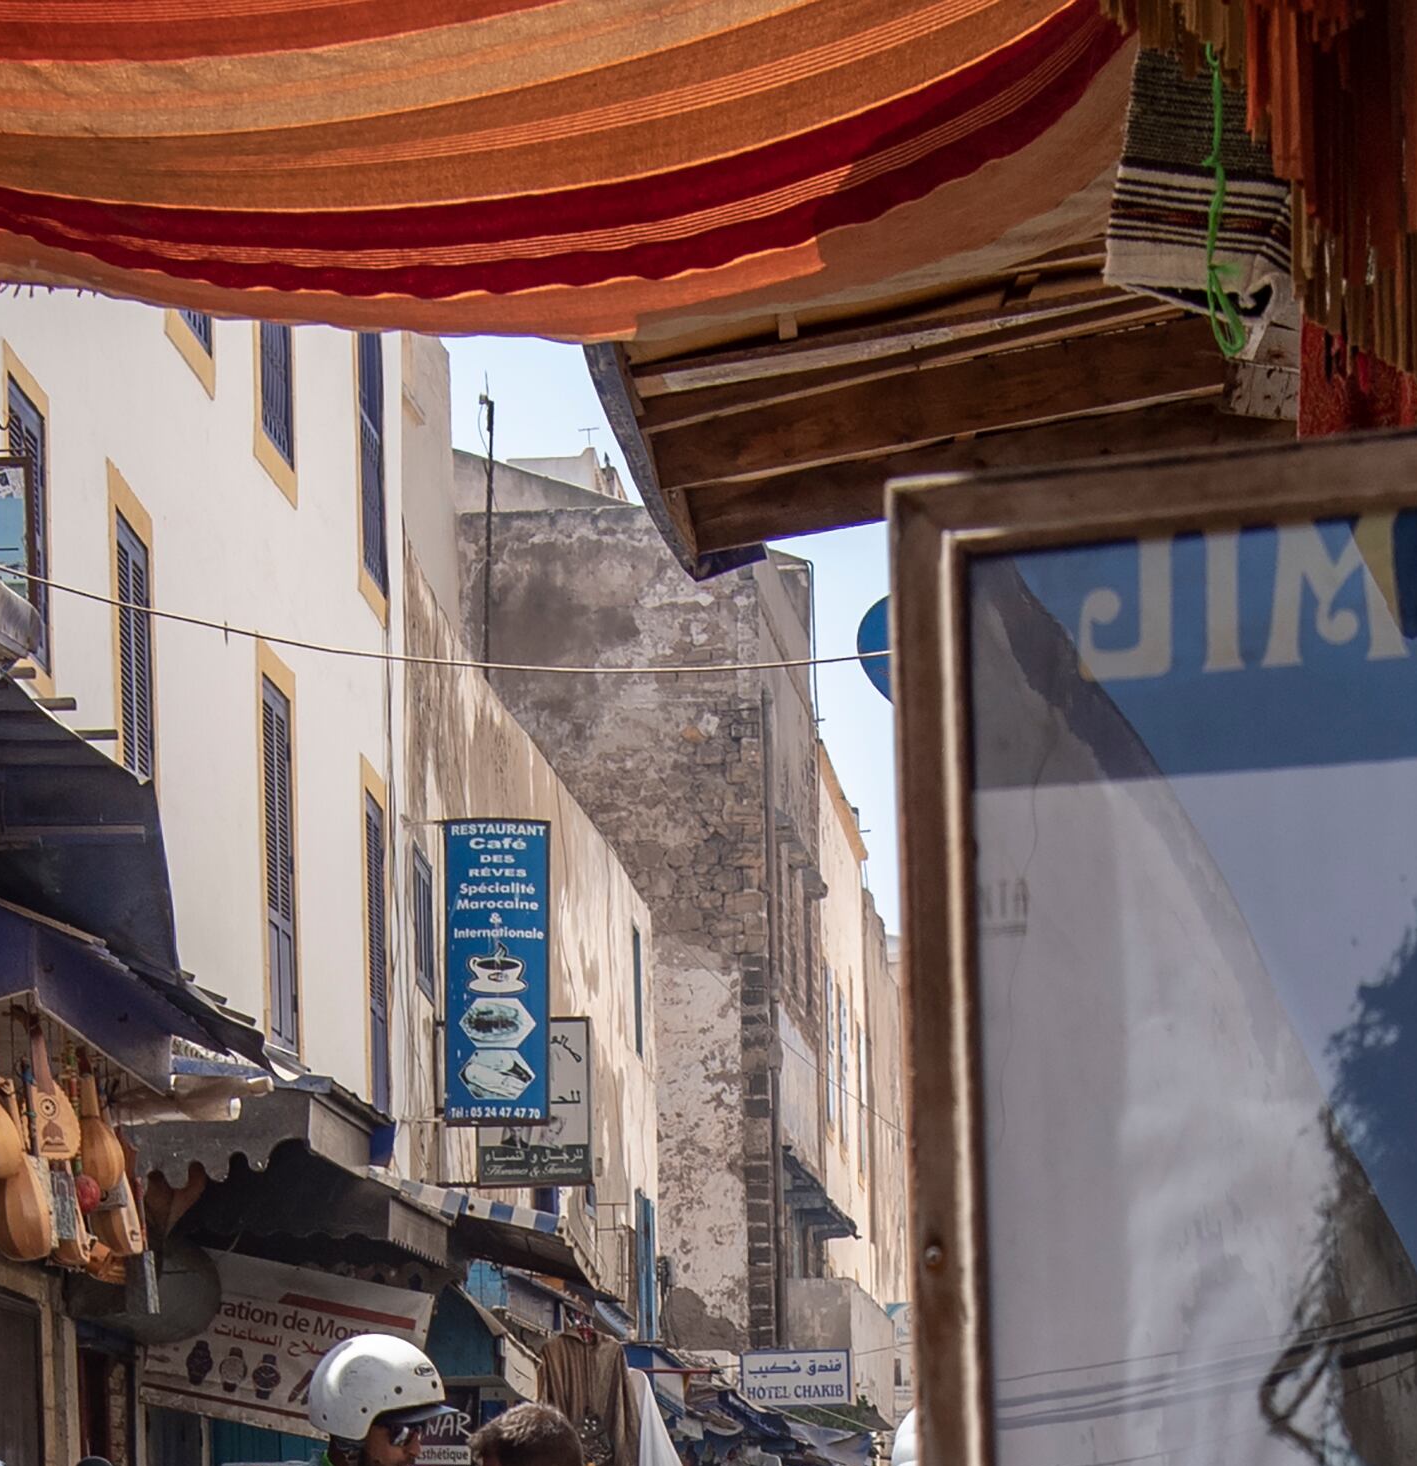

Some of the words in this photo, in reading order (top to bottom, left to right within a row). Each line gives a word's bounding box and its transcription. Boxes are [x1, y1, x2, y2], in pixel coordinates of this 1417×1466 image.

[451, 824, 546, 836] RESTAURANT
[469, 838, 527, 850] Café
[480, 854, 516, 863] DES
[459, 882, 536, 896] Spécialité
[456, 898, 539, 911] Marocaine
[489, 912, 502, 924] &
[453, 926, 544, 940] Internationale
[470, 1106, 483, 1118] 05
[484, 1106, 497, 1117] 24
[498, 1106, 512, 1118] 47
[513, 1107, 527, 1119] 47
[528, 1108, 541, 1119] 70
[216, 1301, 278, 1327] ration
[283, 1311, 310, 1333] de
[806, 1359, 842, 1376] فندق
[794, 1384, 844, 1399] CHAKIB
[417, 1447, 469, 1462] sthétique
